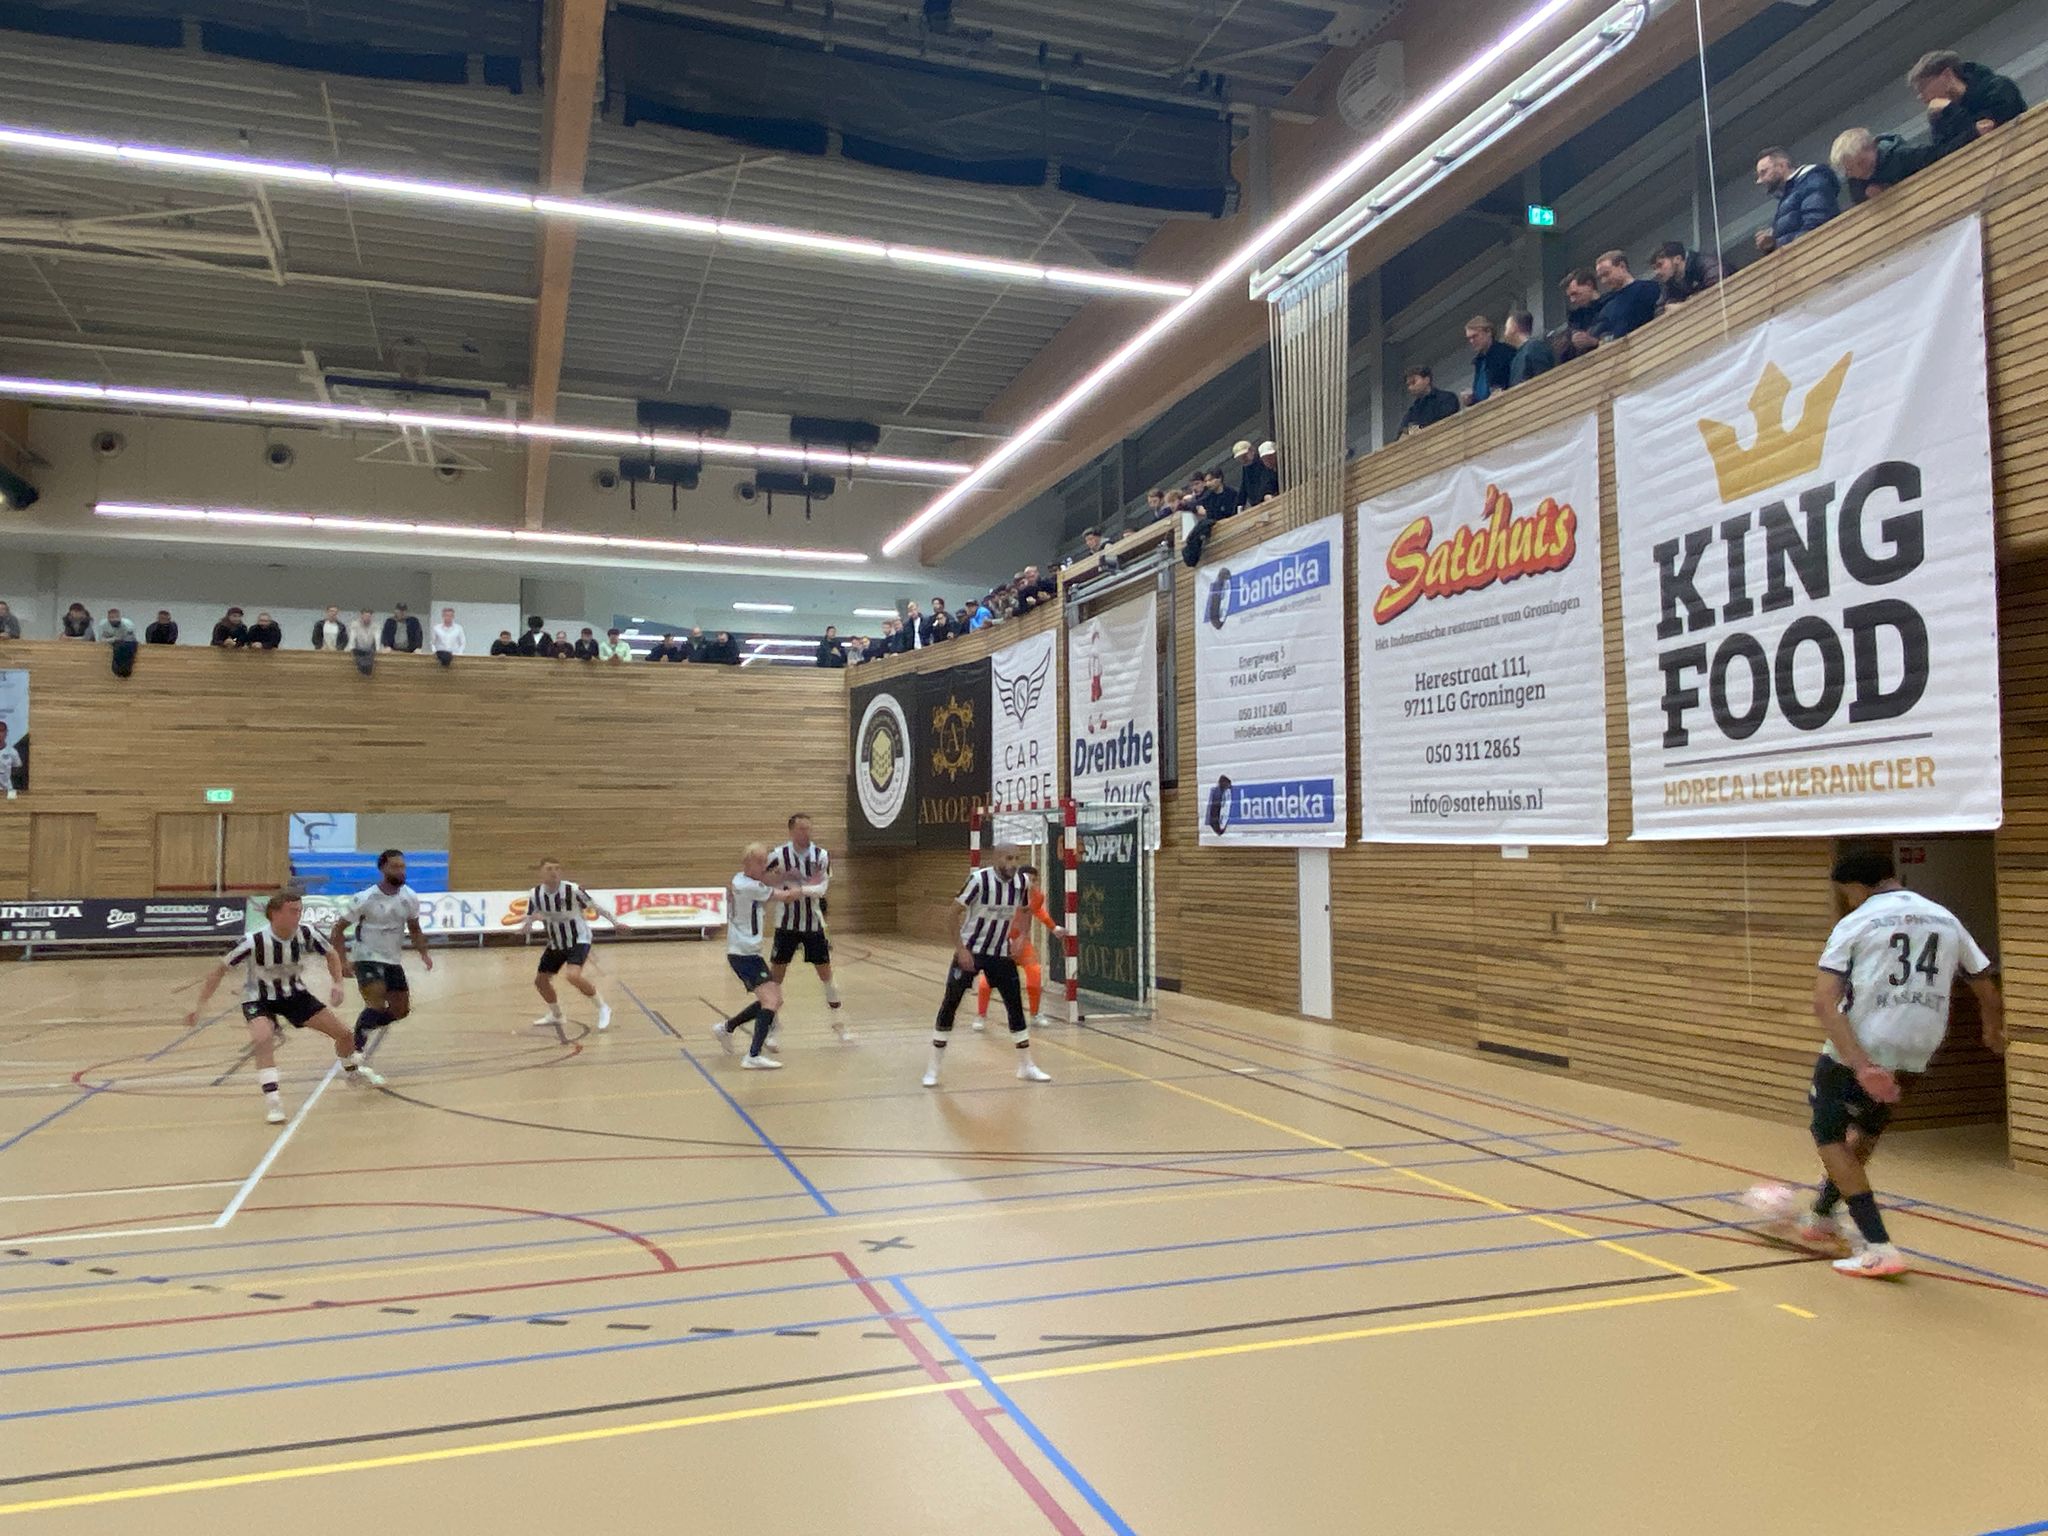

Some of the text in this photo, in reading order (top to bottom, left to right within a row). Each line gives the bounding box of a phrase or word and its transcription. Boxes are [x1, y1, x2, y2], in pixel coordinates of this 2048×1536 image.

[1374, 484, 1577, 625] Satehuis
[1653, 461, 1924, 640] KING
[1238, 555, 1319, 607] bandeka
[1502, 610, 1521, 624] van
[1523, 596, 1581, 619] Groningen
[1258, 665, 1297, 682] Groningen
[1415, 655, 1531, 692] Herestraat 111,
[1659, 599, 1929, 748] FOOD
[1404, 683, 1546, 718] 9711 LG Groningen
[1005, 740, 1039, 771] CAR
[1074, 719, 1153, 777] Drenthe
[1425, 736, 1521, 764] 050 311 2865
[995, 772, 1051, 807] STORE
[1663, 756, 1936, 806] HORECA LEVERANCIER
[1240, 784, 1325, 820] bandeka
[1410, 788, 1544, 818] info@satehuis.nl
[1083, 833, 1133, 864] SUPPLY
[1888, 931, 1939, 987] 34
